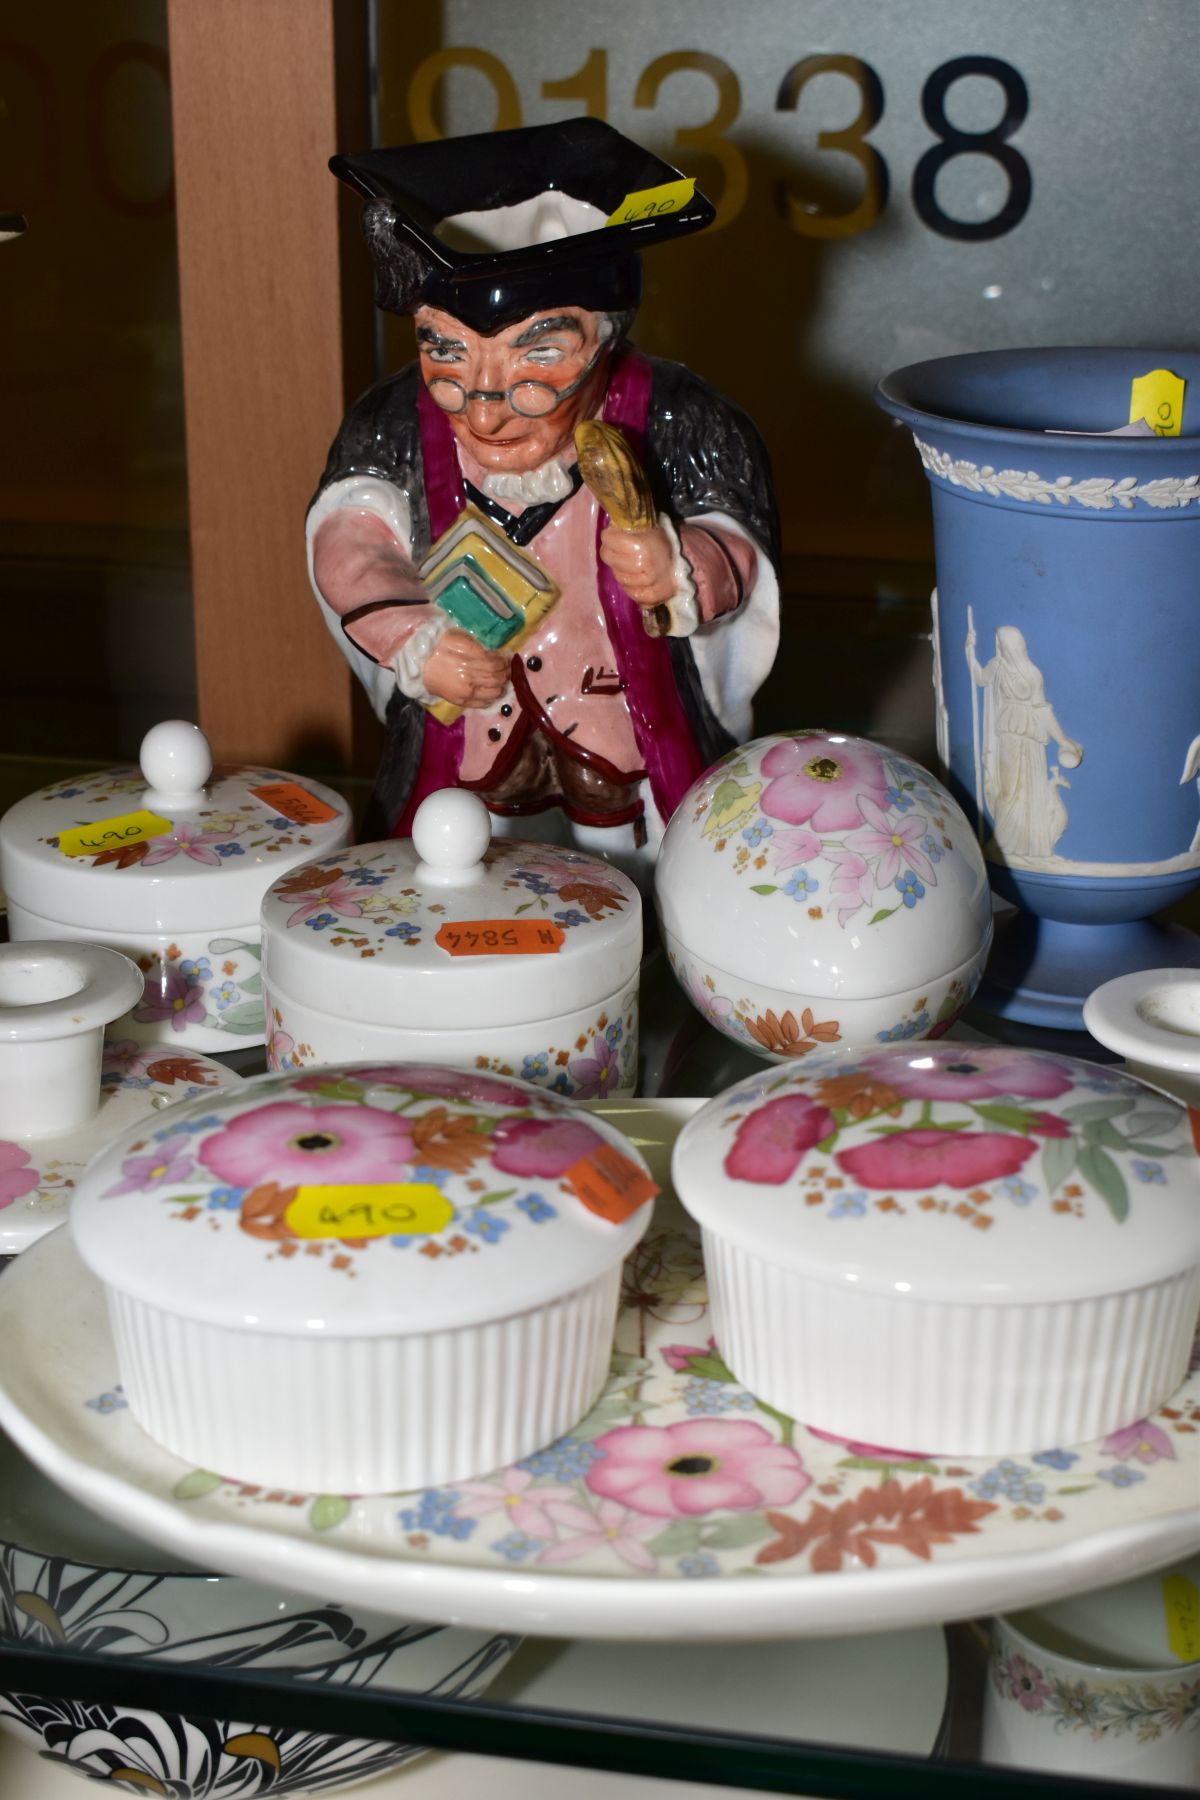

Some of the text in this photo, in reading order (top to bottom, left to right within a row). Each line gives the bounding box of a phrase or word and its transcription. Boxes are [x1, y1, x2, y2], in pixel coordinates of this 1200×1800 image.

[624, 200, 675, 222] 490
[80, 826, 142, 847] 490
[446, 929, 519, 948] 5844
[319, 1203, 417, 1225] 490
